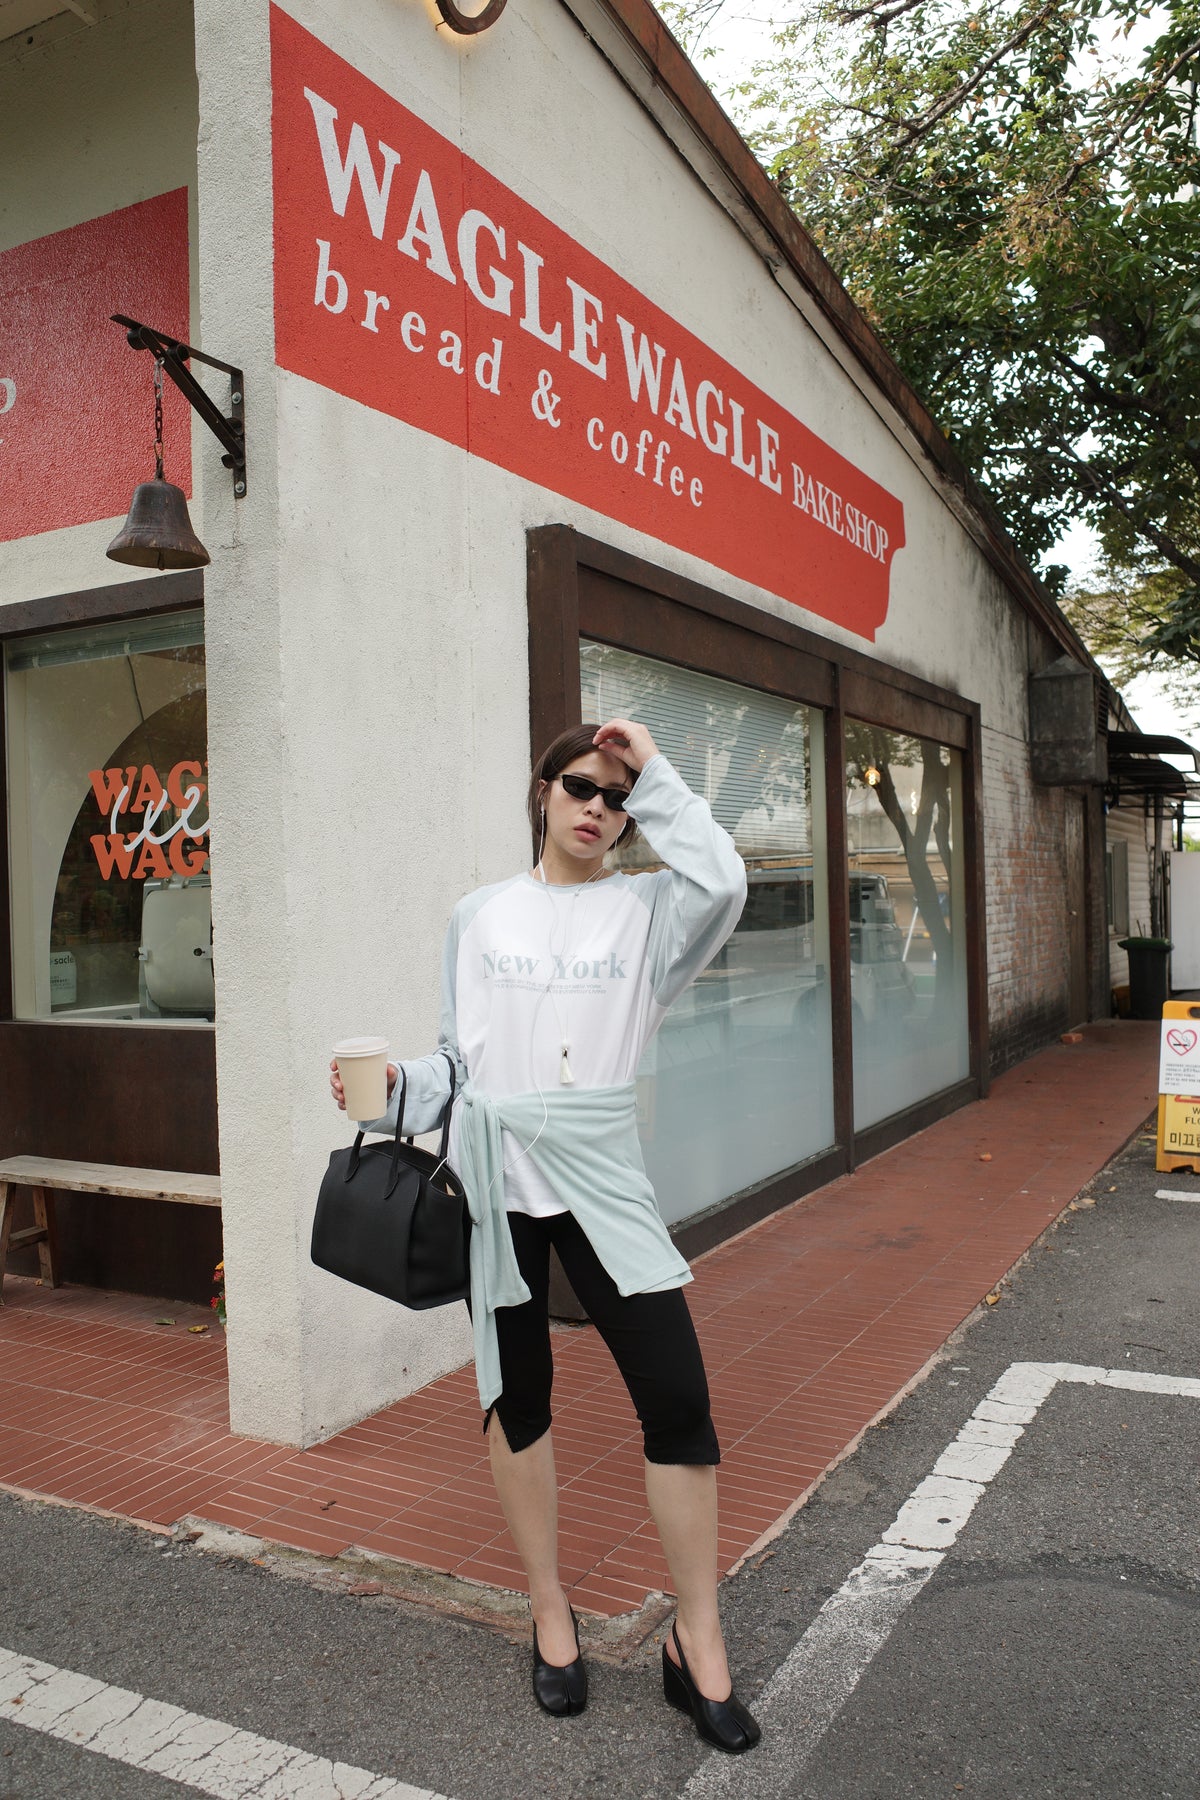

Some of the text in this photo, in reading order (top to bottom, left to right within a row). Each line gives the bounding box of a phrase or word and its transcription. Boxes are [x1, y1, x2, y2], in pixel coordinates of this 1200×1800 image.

[303, 88, 889, 565] WAGLE WAGLE BAKE SHOP
[314, 238, 705, 508] bread & coffee
[88, 760, 209, 816] WAG
[90, 831, 211, 881] WAG
[481, 950, 628, 980] New York
